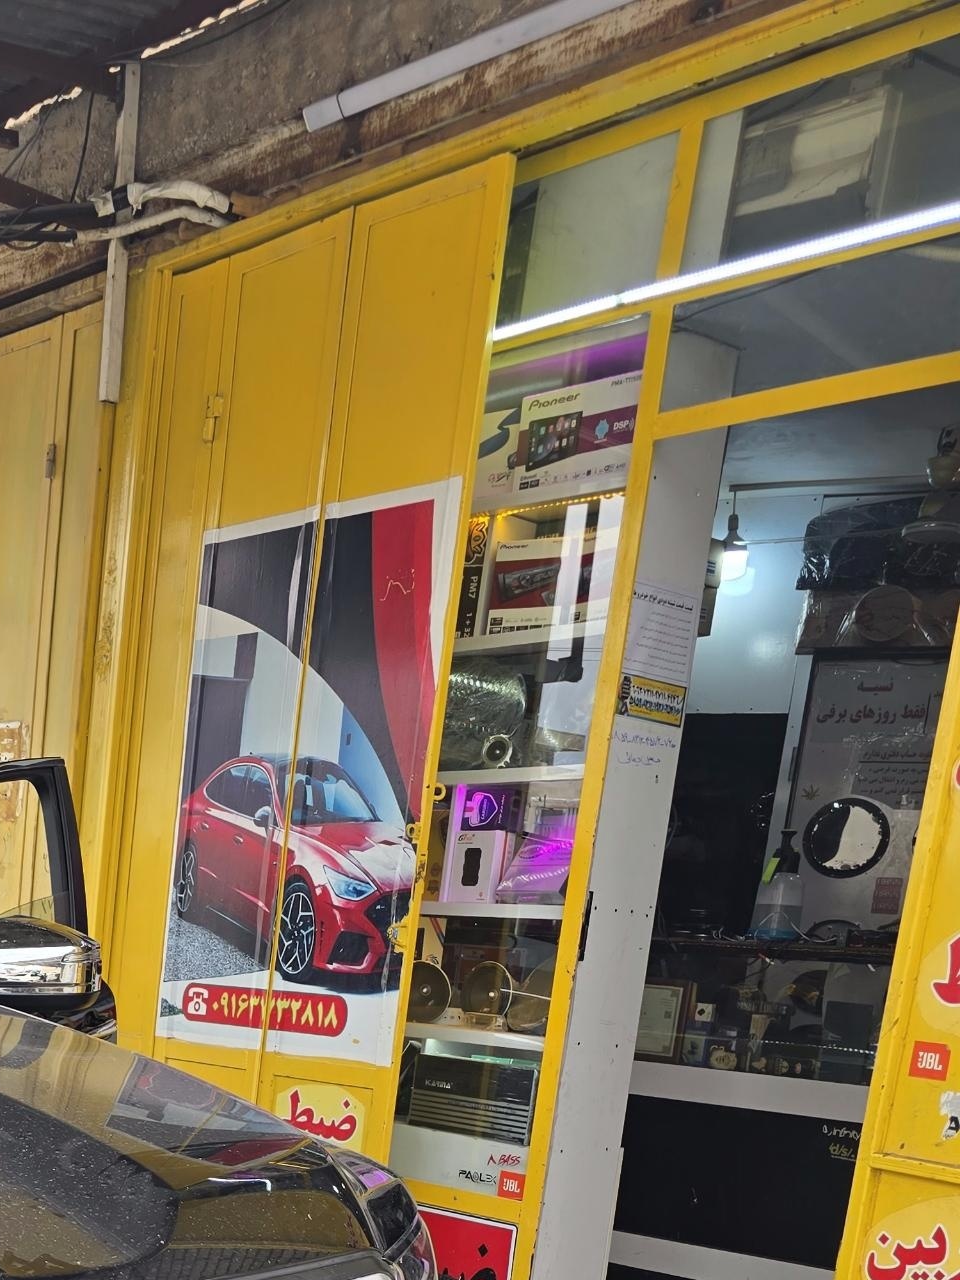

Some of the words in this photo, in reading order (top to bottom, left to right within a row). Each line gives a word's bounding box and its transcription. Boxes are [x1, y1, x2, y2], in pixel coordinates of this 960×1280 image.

[528, 392, 580, 411] Pioneer
[613, 420, 630, 431] DSP
[857, 678, 894, 695] نسیه
[816, 703, 848, 724] برفی
[849, 703, 897, 725] روزهای
[901, 703, 926, 720] فقط
[918, 1051, 942, 1071] JBL
[498, 1154, 520, 1166] BASS
[503, 1178, 521, 1193] JBL
